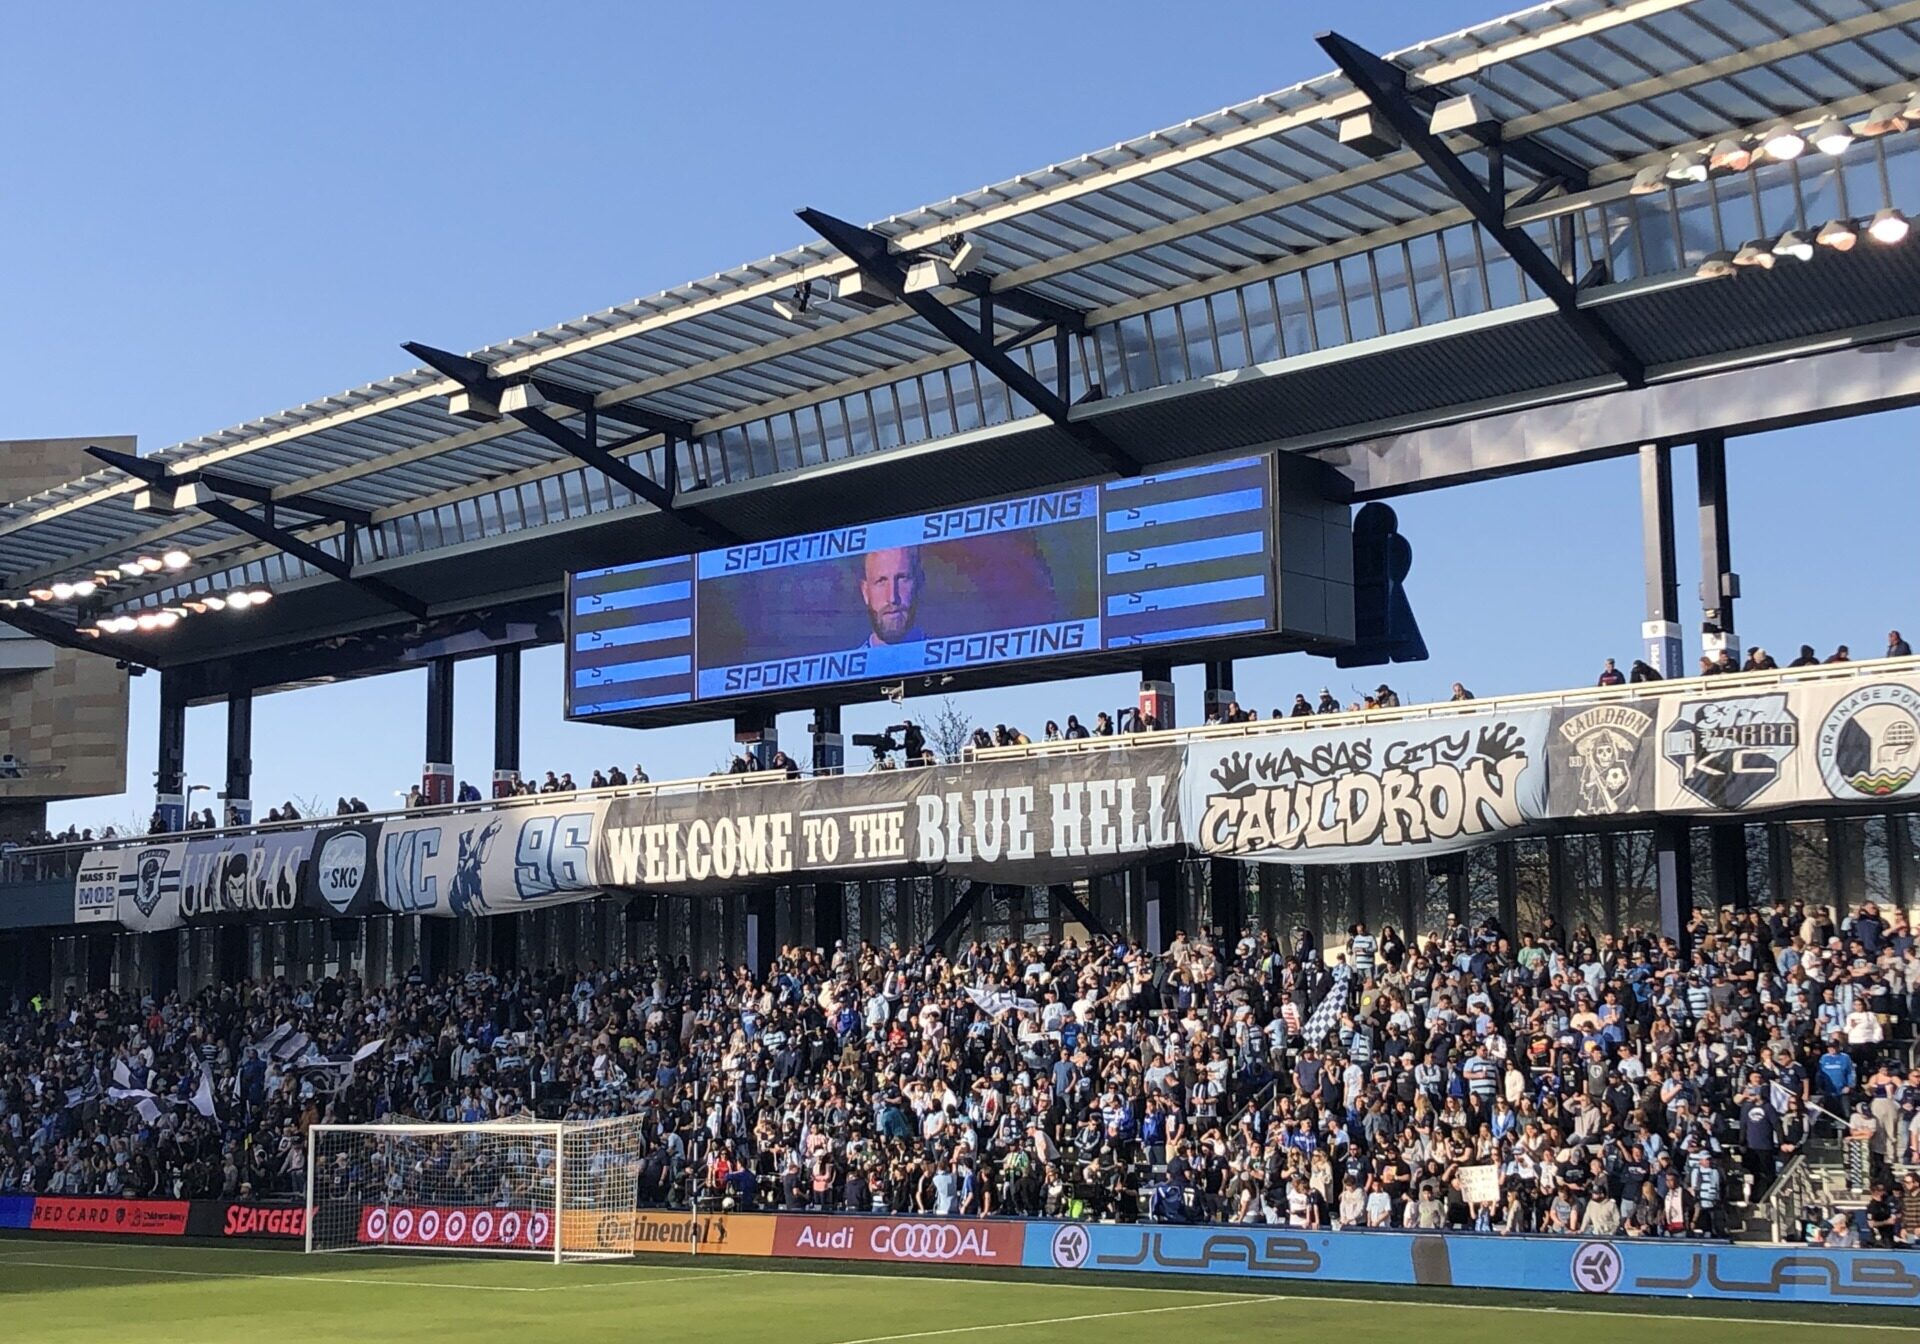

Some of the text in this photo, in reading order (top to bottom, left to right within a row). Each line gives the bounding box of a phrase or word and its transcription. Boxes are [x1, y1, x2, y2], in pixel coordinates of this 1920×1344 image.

[923, 491, 1083, 541] SPORTING
[725, 528, 867, 572] SPORTING
[924, 623, 1085, 666] SPORTING
[725, 652, 868, 692] SPORTING
[1564, 704, 1650, 739] CAULDRON
[1822, 689, 1881, 757] DRAINAGE
[1256, 730, 1470, 783] KANSAS CITY
[1200, 750, 1530, 855] CAULDRON
[608, 775, 1175, 884] WELCOME TO THE BLUE HELL
[79, 871, 117, 882] MASS ST
[330, 867, 358, 888] SKC
[384, 827, 441, 911] KC
[515, 813, 595, 900] 96
[79, 886, 115, 905] MOB
[180, 846, 302, 917] ULTRAS
[34, 1206, 109, 1223] RED CARD
[797, 1225, 854, 1249] Audi
[1097, 1232, 1322, 1273] JLAB
[1636, 1253, 1920, 1298] JLAB
